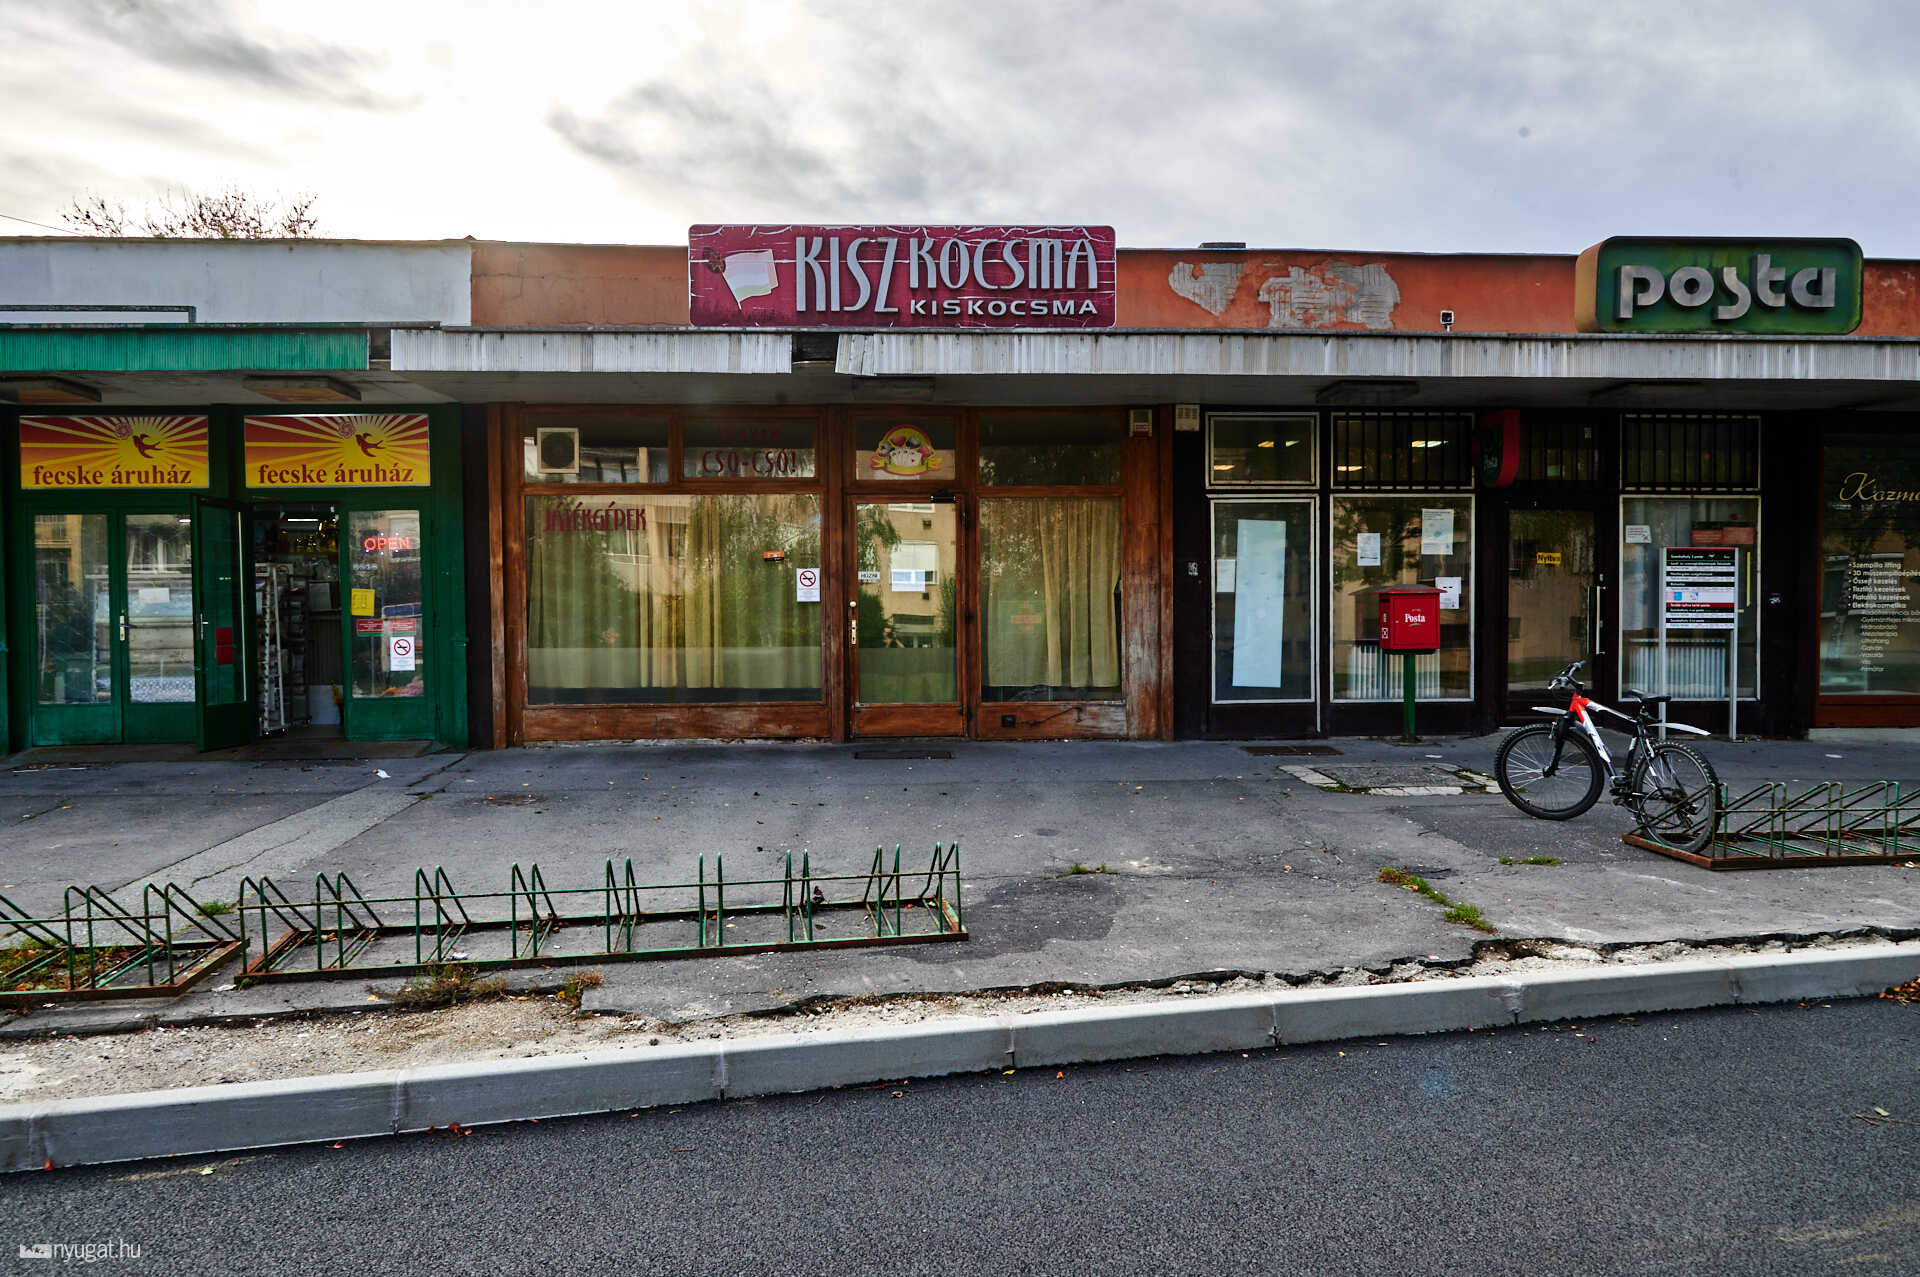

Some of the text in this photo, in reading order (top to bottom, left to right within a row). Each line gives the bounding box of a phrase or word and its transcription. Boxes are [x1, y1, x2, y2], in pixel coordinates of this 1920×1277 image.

[1616, 254, 1836, 320] posta
[910, 299, 1099, 316] KISKOCSMA
[33, 464, 193, 485] fecske áruház
[258, 462, 414, 484] fecske áruház
[543, 501, 647, 532] JÁTÉKGÉPEK
[364, 537, 411, 550] OPEN
[1404, 613, 1426, 623] Posta
